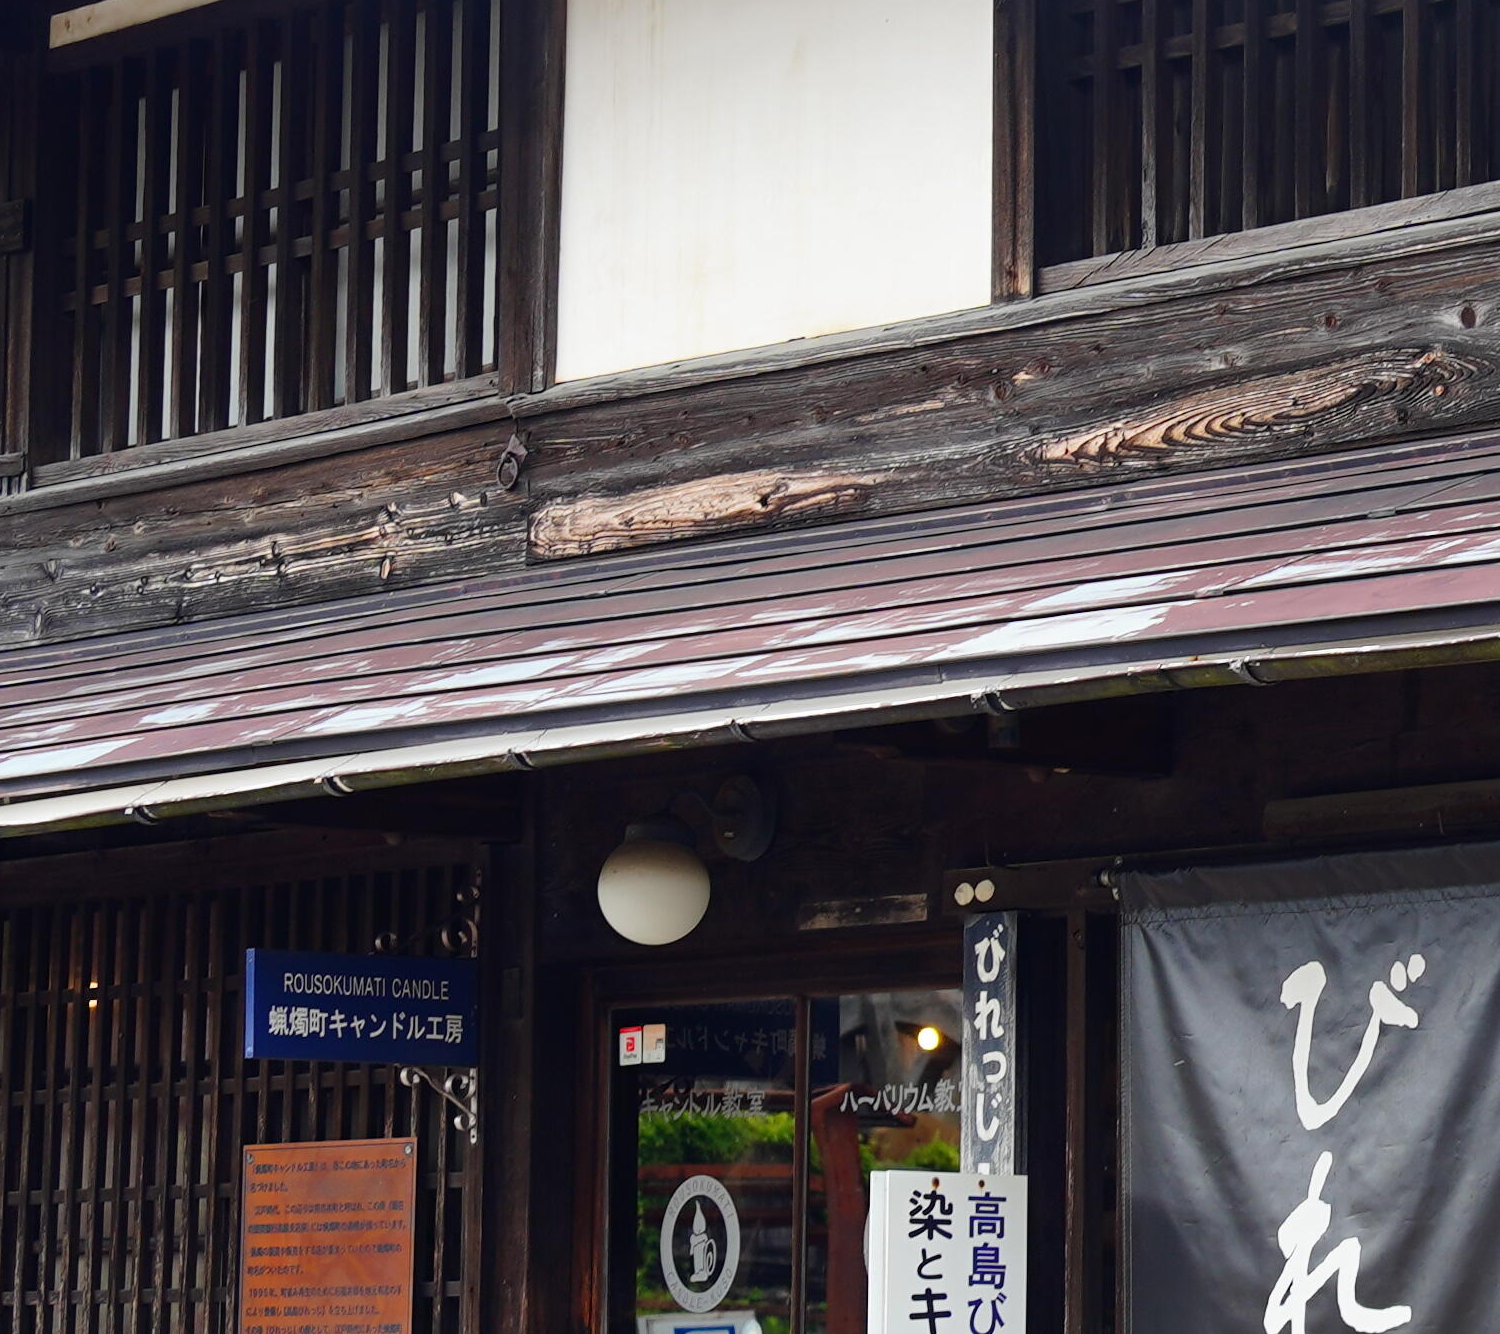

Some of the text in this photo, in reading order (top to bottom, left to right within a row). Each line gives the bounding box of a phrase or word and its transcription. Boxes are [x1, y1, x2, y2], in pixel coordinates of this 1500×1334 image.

[284, 973, 449, 1000] ROUSOKUMATI CANDLE
[268, 1005, 463, 1044] 蝋燭町キャンドル工房
[973, 923, 1007, 1174] びれっじ
[640, 1080, 767, 1123] キャンドル教室
[840, 1078, 962, 1116] ハーバリウム教
